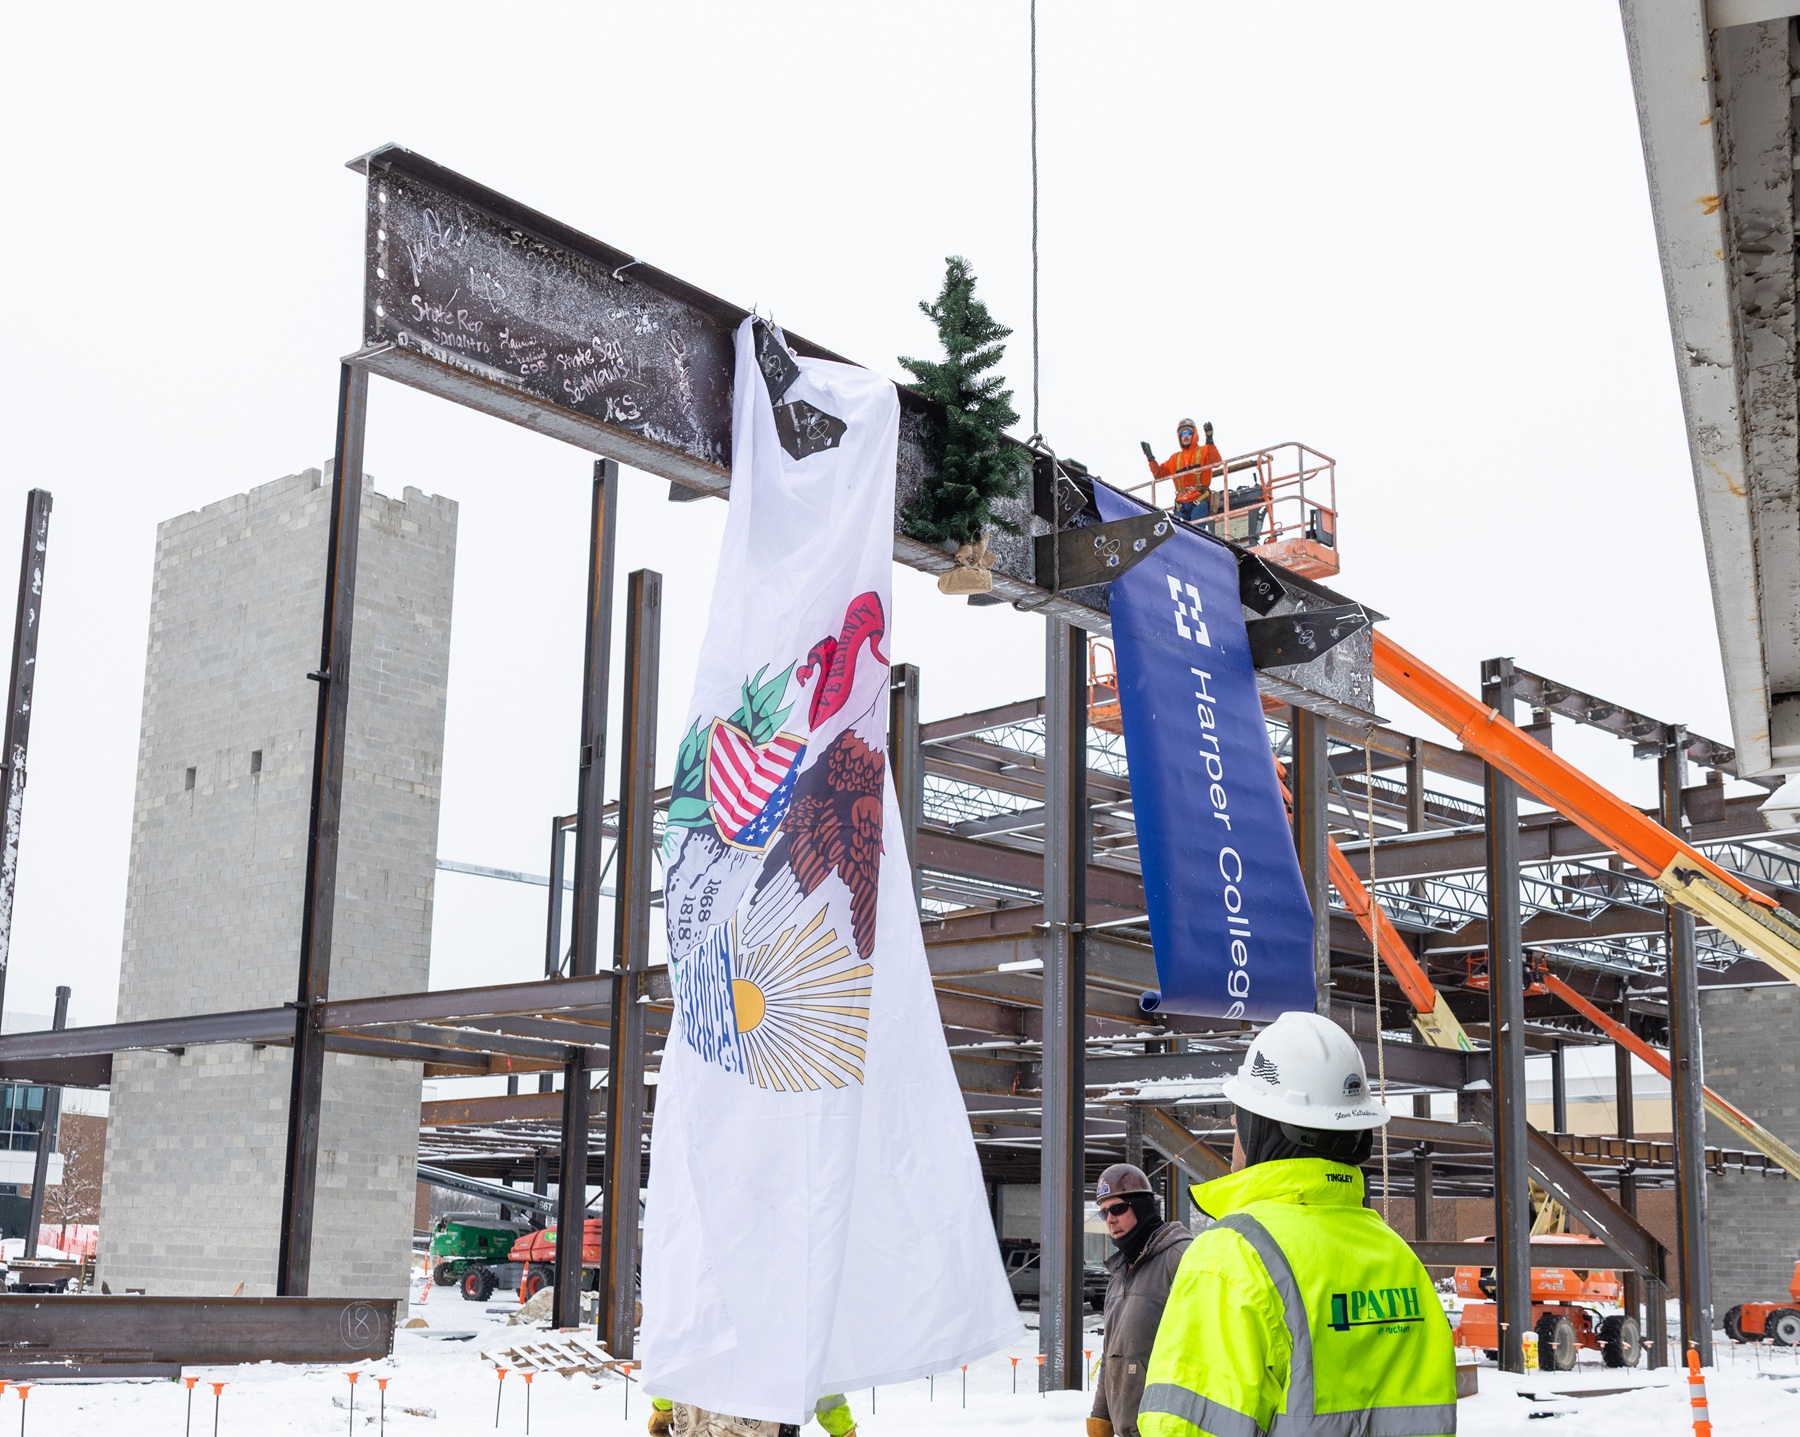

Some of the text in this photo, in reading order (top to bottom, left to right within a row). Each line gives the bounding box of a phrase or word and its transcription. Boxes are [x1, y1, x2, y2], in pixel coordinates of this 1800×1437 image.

[411, 294, 455, 325] State
[557, 347, 595, 370] State
[1190, 667, 1232, 831] Harper
[678, 894, 694, 941] 1818
[698, 879, 722, 923] 1868
[1325, 1173, 1353, 1183] TINGLEY
[1351, 1287, 1420, 1320] PATH
[347, 1306, 371, 1339] 18
